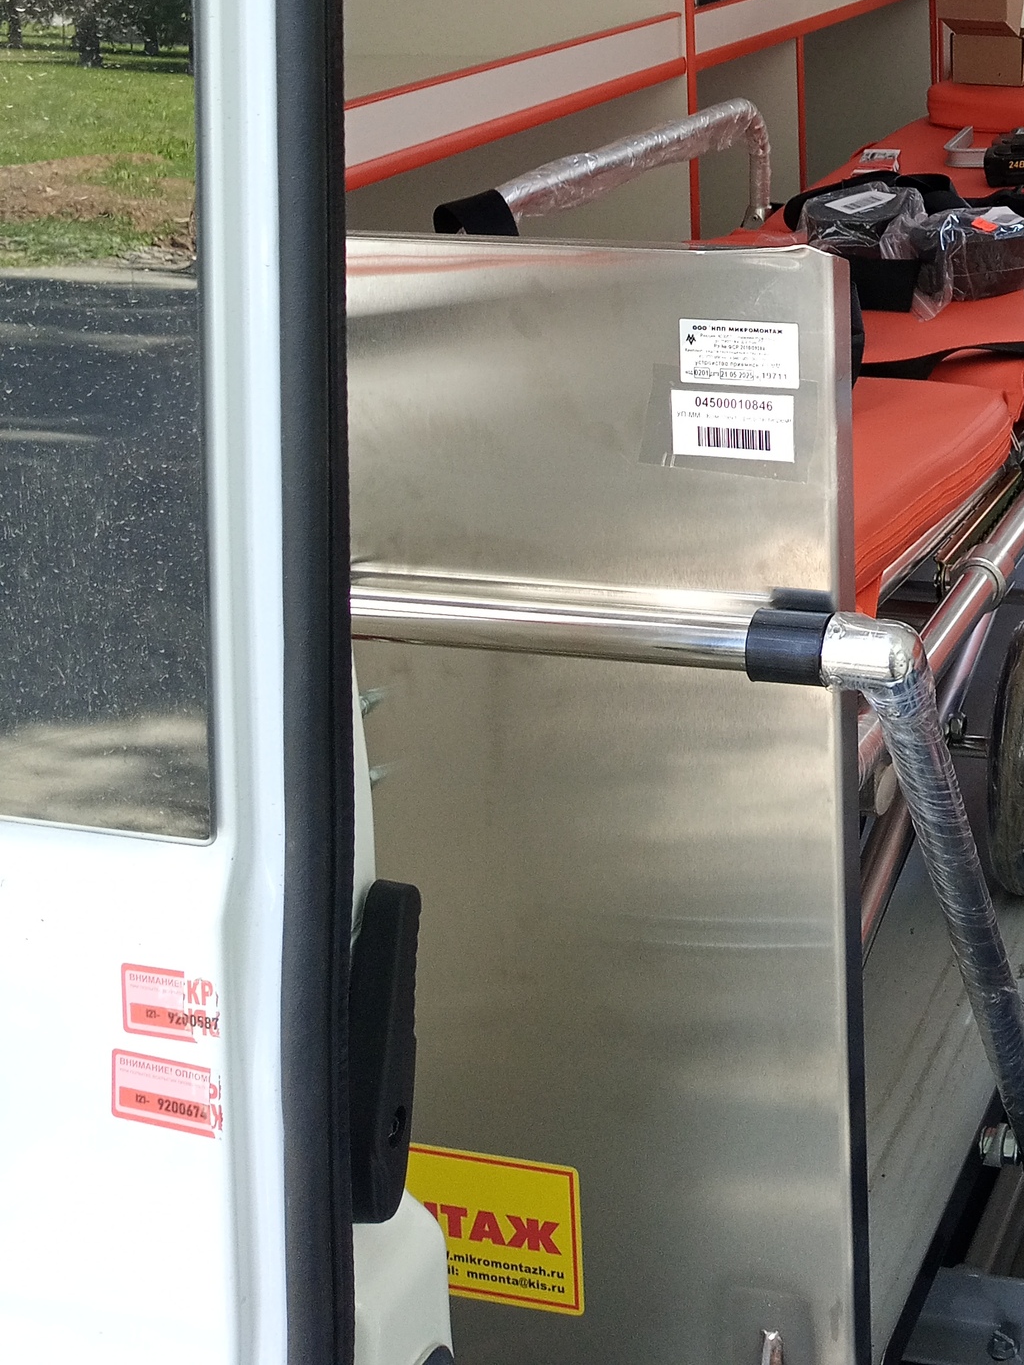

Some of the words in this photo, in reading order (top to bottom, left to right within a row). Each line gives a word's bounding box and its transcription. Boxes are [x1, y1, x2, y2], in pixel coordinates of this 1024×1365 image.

[728, 326, 783, 334] МИКРОМОНТАЖ
[694, 396, 773, 411] 04500010846
[129, 973, 183, 988] ВНИМАНИЕ!
[119, 1057, 173, 1075] ВНИМАНИЕ!
[446, 1250, 565, 1279] .mikromontazh.ru
[467, 1269, 565, 1294] mmonta@kis.ru
